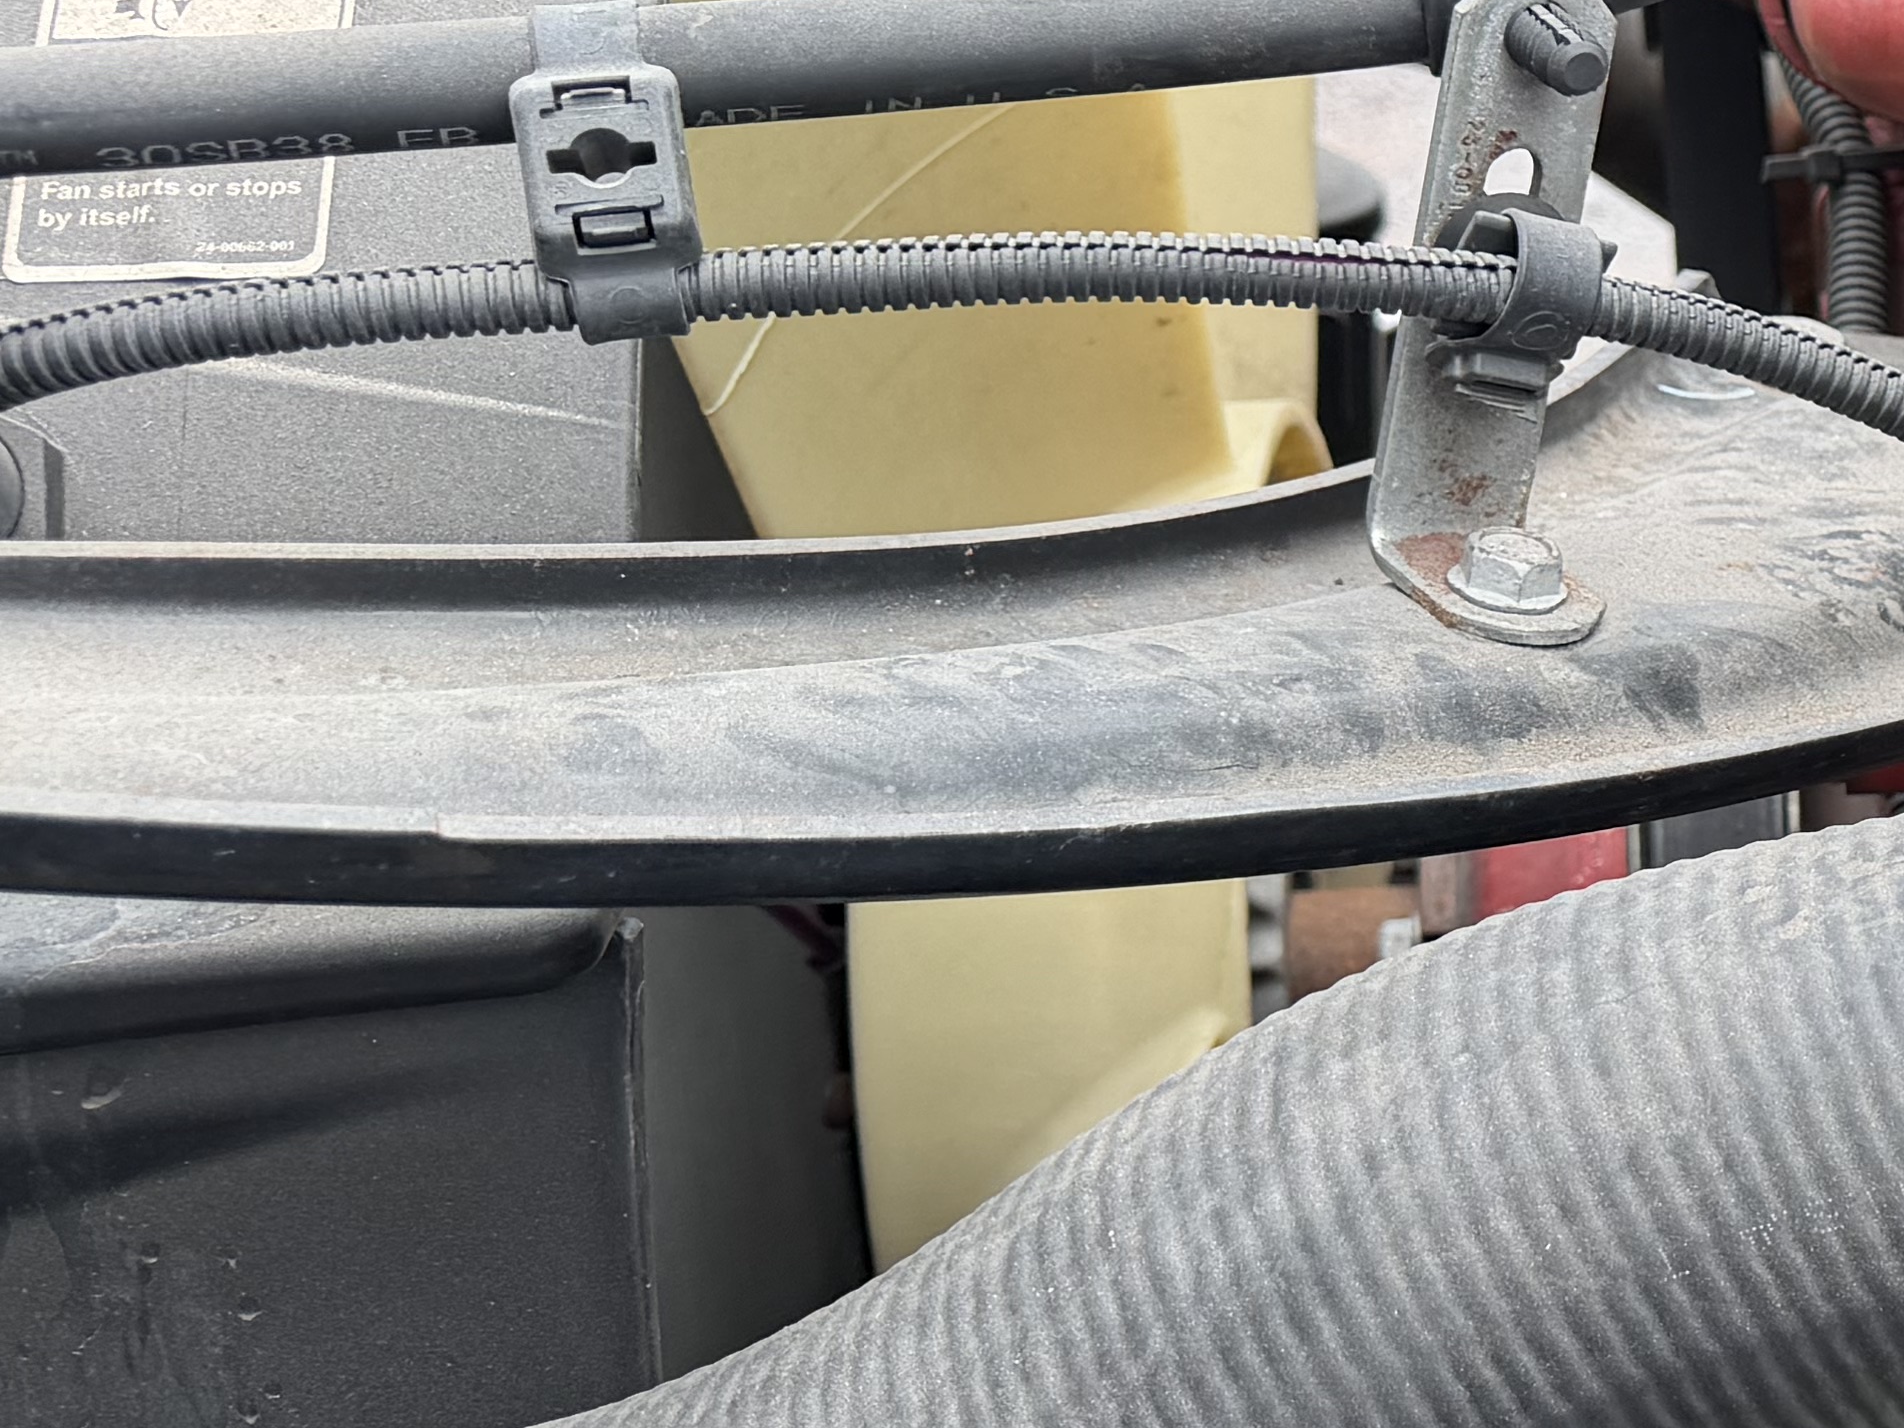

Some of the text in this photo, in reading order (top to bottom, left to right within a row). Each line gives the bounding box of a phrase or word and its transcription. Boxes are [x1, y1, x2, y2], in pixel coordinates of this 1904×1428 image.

[41, 178, 302, 200] Fan starts or stops
[37, 205, 155, 231] by itself.
